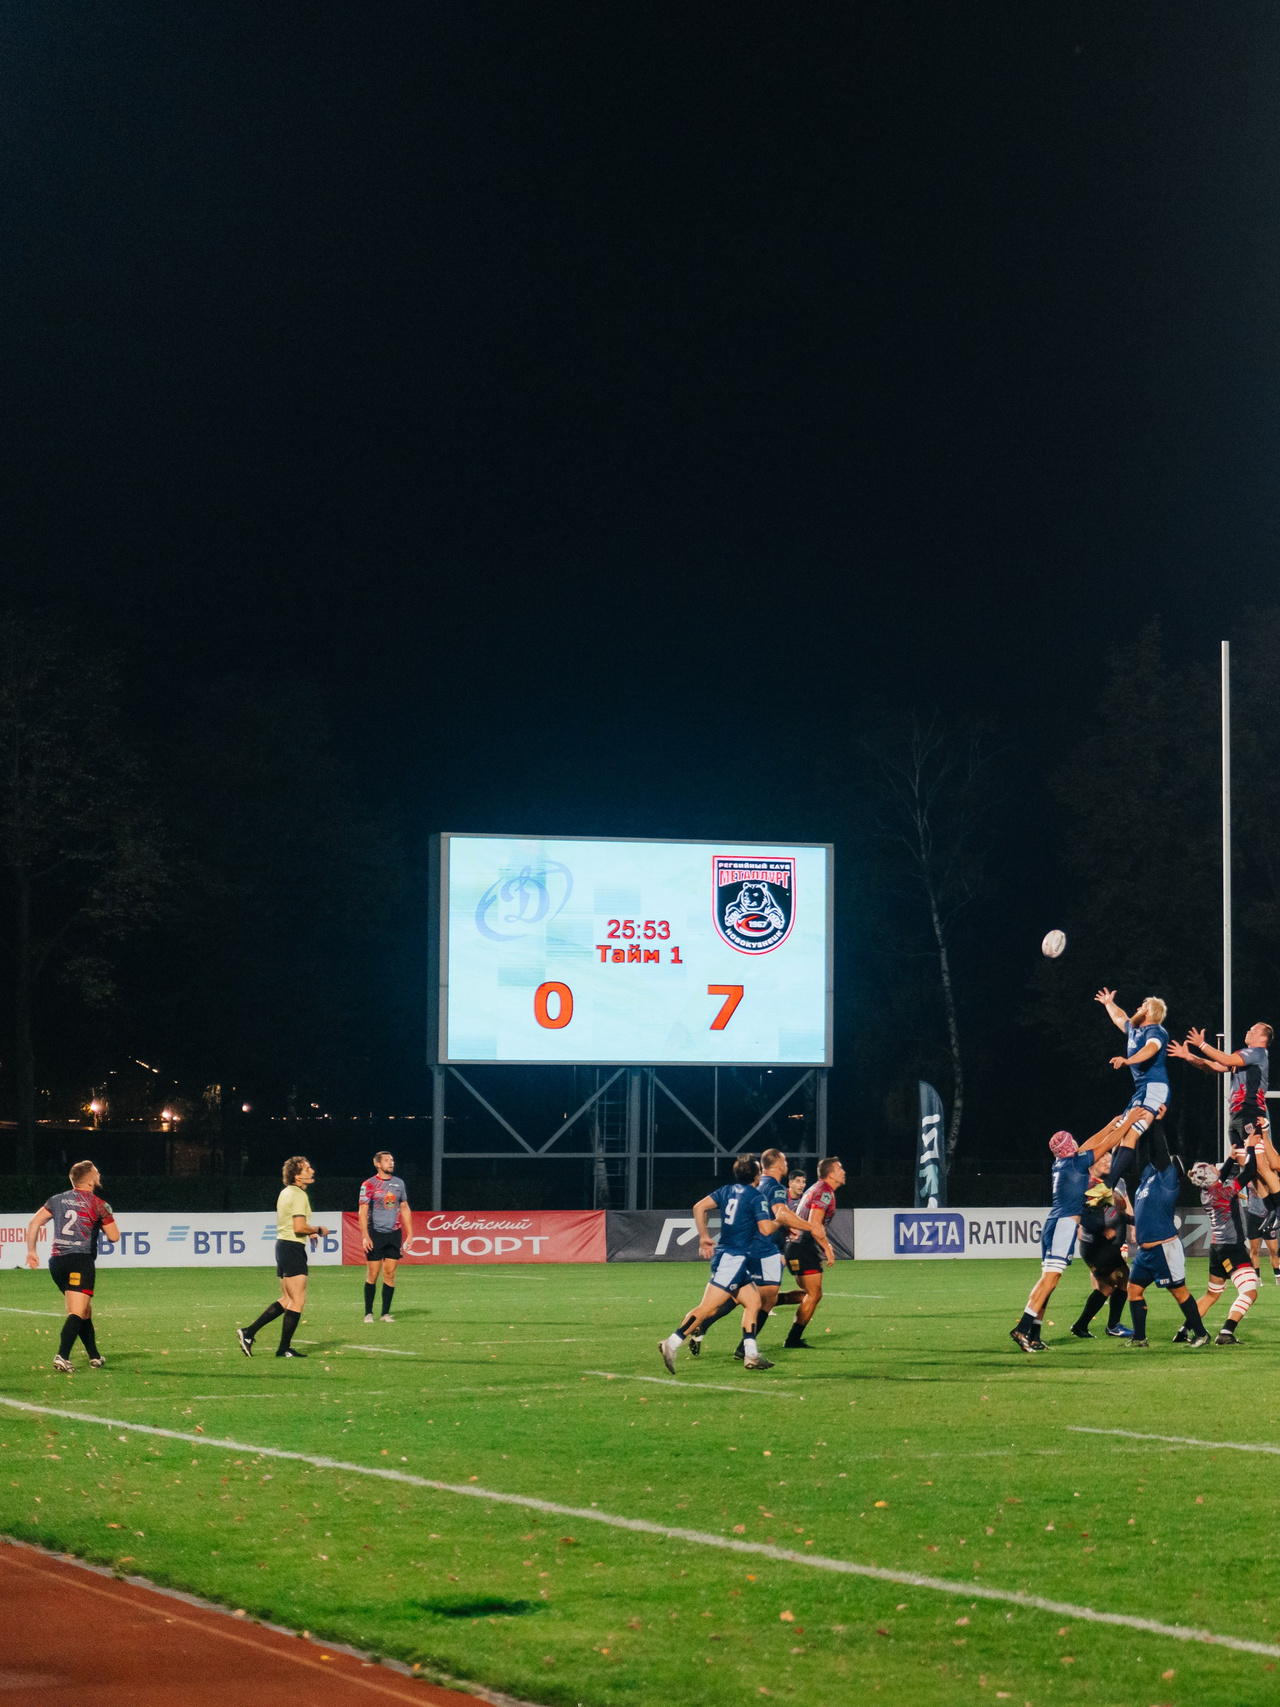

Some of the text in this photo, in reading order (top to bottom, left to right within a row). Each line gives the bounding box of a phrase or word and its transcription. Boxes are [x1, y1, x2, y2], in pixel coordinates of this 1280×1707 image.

[718, 869, 790, 889] МЕТАЛЛУРГ
[607, 920, 671, 940] 25:53
[596, 944, 683, 964] Тайм 1
[534, 981, 574, 1030] 0
[707, 984, 745, 1030] 7
[62, 1210, 77, 1236] 2
[427, 1214, 533, 1231] Советский
[724, 1199, 738, 1225] 9
[194, 1231, 246, 1254] ВТБ
[403, 1236, 549, 1257] СПОРТ
